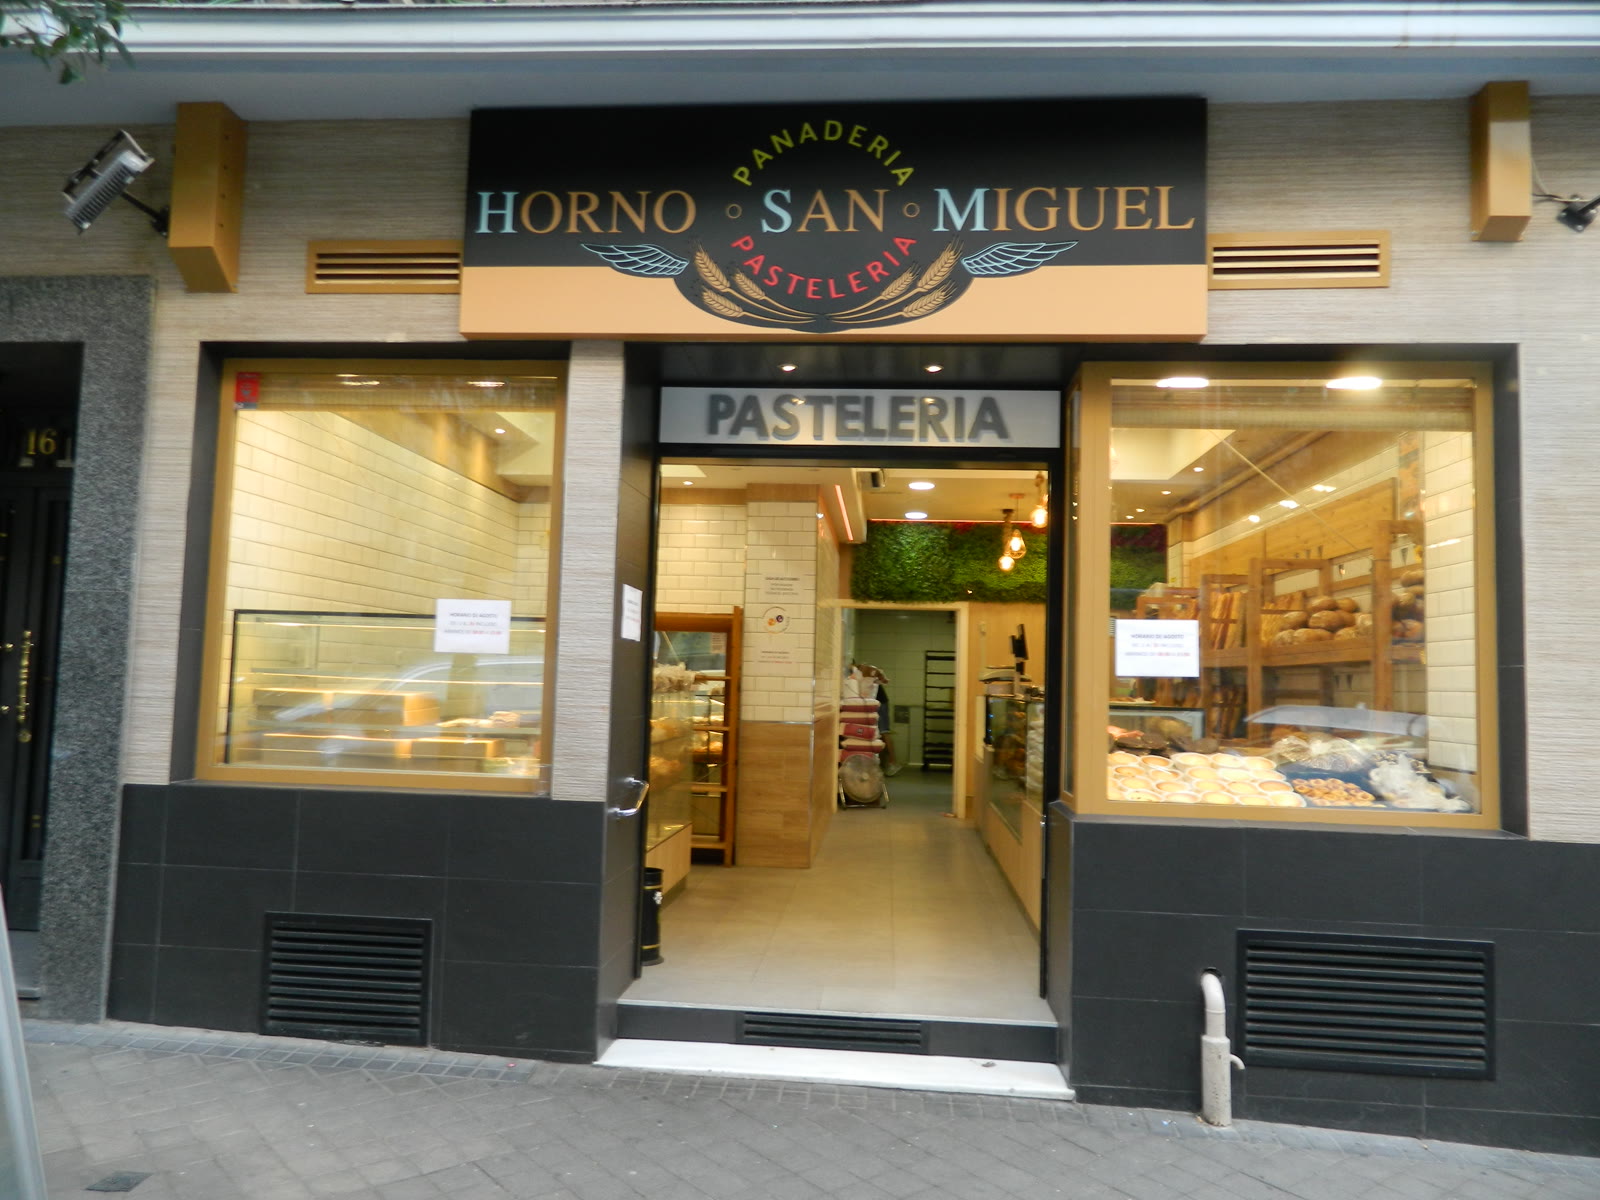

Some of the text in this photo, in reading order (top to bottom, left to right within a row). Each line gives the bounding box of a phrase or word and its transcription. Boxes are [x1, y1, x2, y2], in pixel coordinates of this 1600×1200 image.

[733, 120, 914, 186] PANADERIA
[475, 186, 1195, 234] HORNO SAN MIGUEL
[731, 235, 917, 299] PASTELERIA
[26, 428, 57, 455] 16
[705, 393, 1011, 442] PASTELERIA
